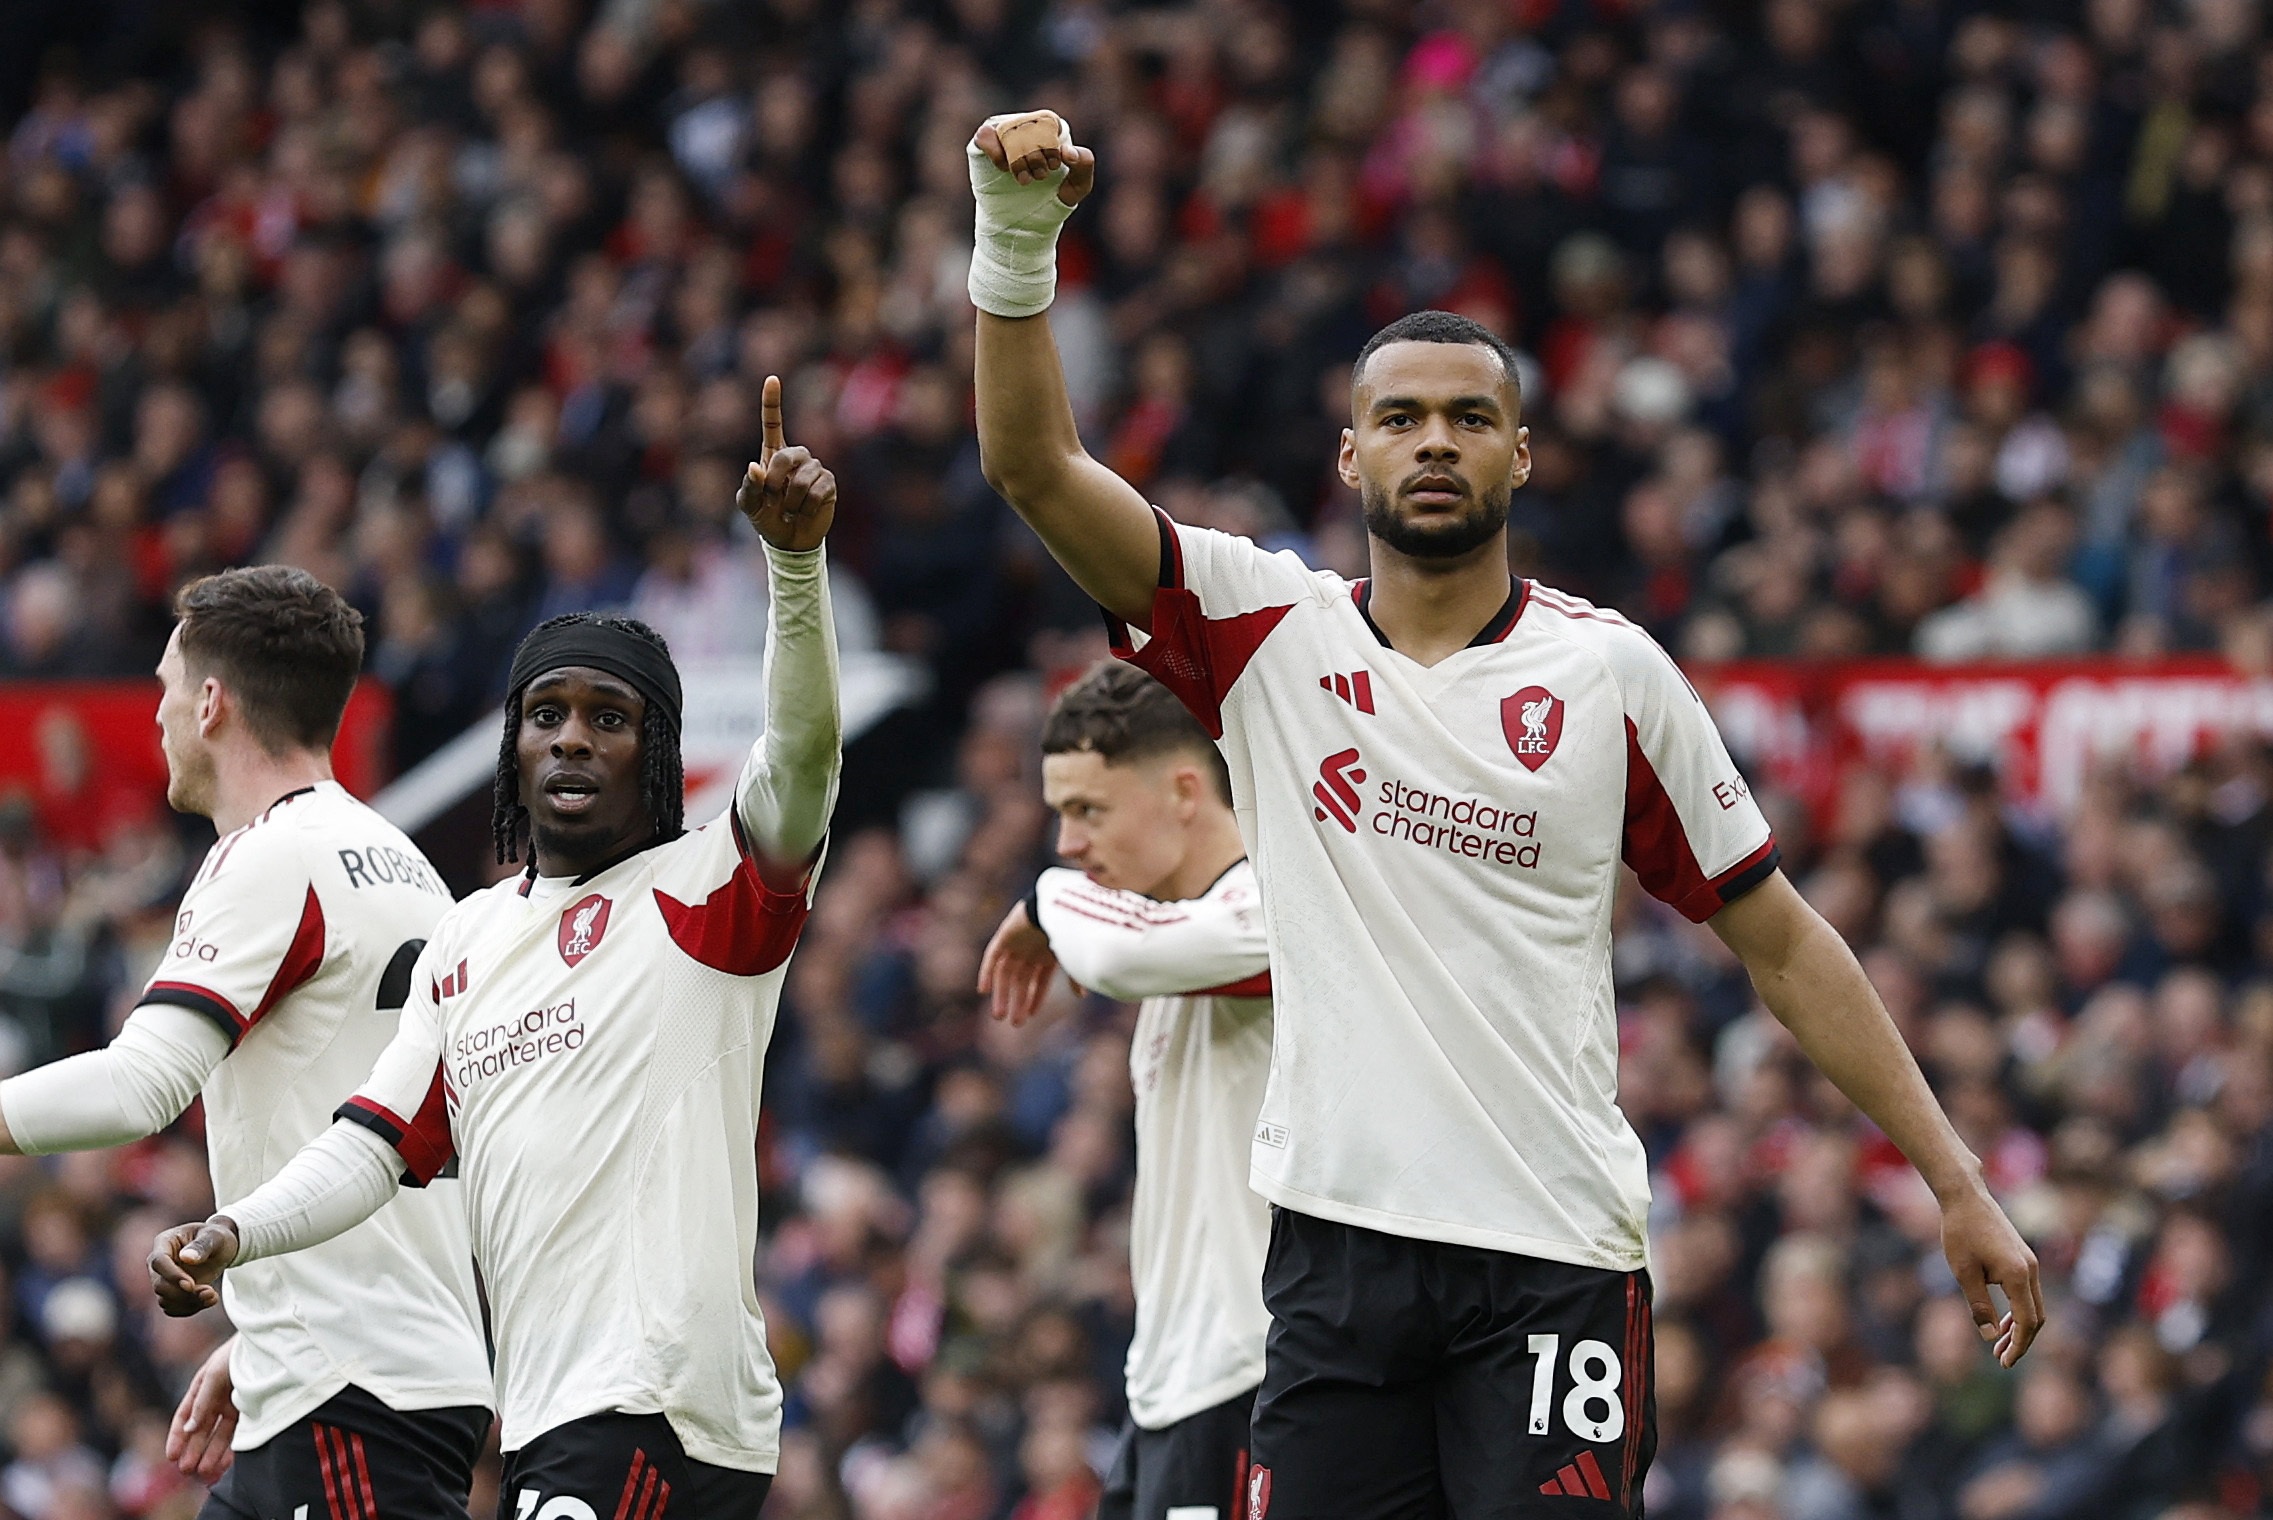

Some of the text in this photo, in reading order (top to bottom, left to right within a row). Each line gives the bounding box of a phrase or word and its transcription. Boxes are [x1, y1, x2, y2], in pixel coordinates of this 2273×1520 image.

[1372, 809, 1542, 870] chartered
[1378, 779, 1538, 838] standard
[456, 996, 576, 1061] standard
[458, 1022, 585, 1088] chartered
[1527, 1333, 1625, 1444] 18
